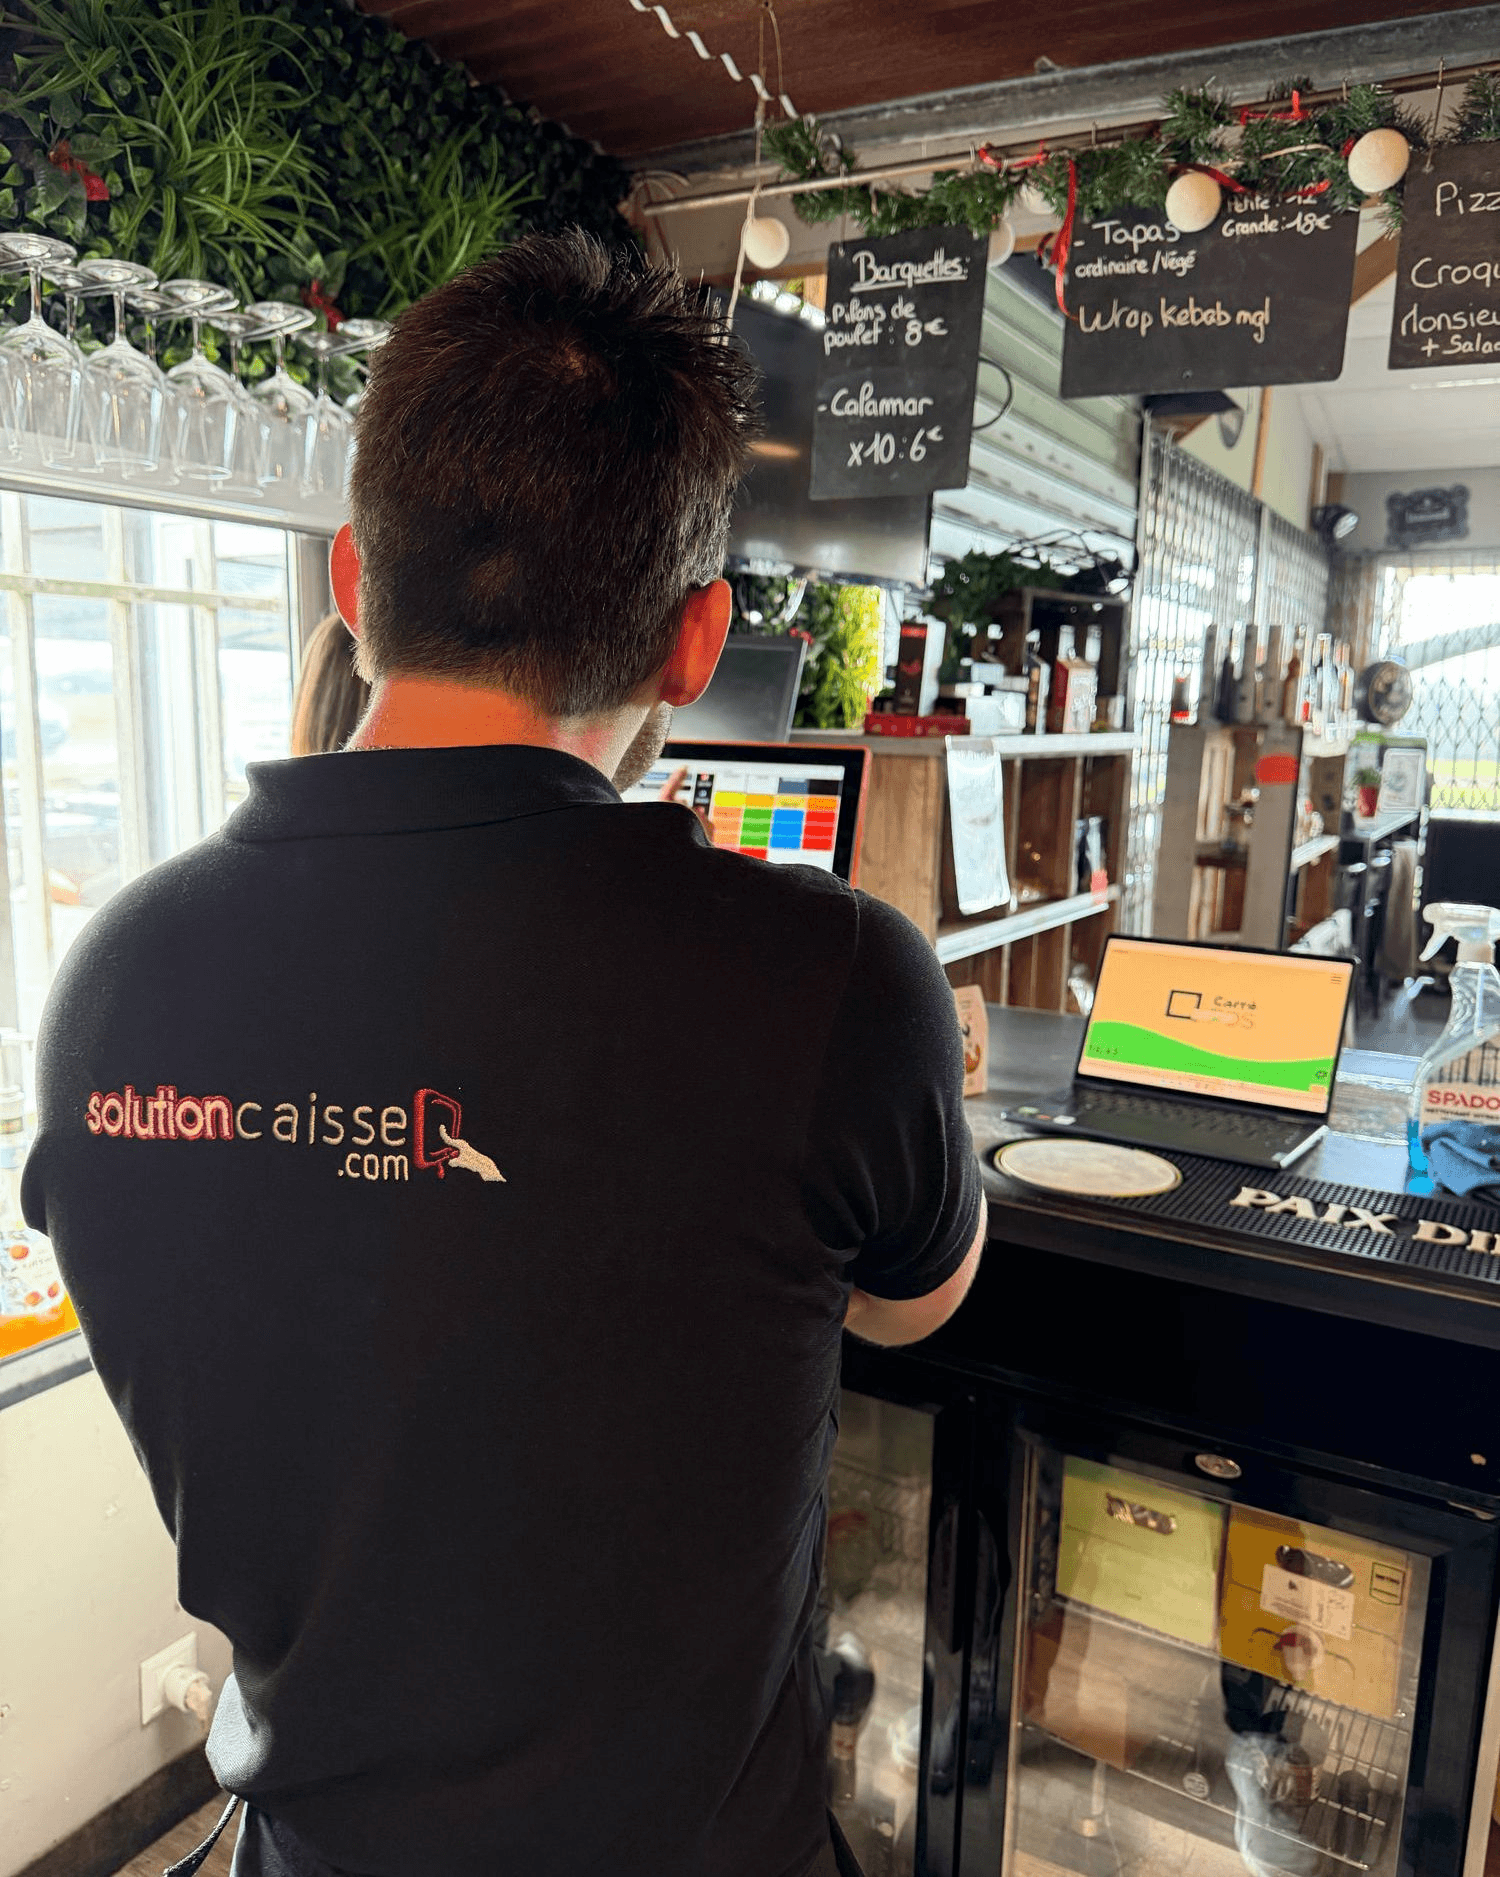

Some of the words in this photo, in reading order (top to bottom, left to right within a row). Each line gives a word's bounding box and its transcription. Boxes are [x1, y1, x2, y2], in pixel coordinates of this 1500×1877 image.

[1091, 220, 1180, 255] Tapas
[1074, 255, 1149, 278] ordinaire
[890, 295, 917, 319] de
[823, 324, 883, 356] poulet
[830, 381, 934, 418] Calamar
[336, 1151, 410, 1182] .com
[1229, 1186, 1398, 1237] PAIX
